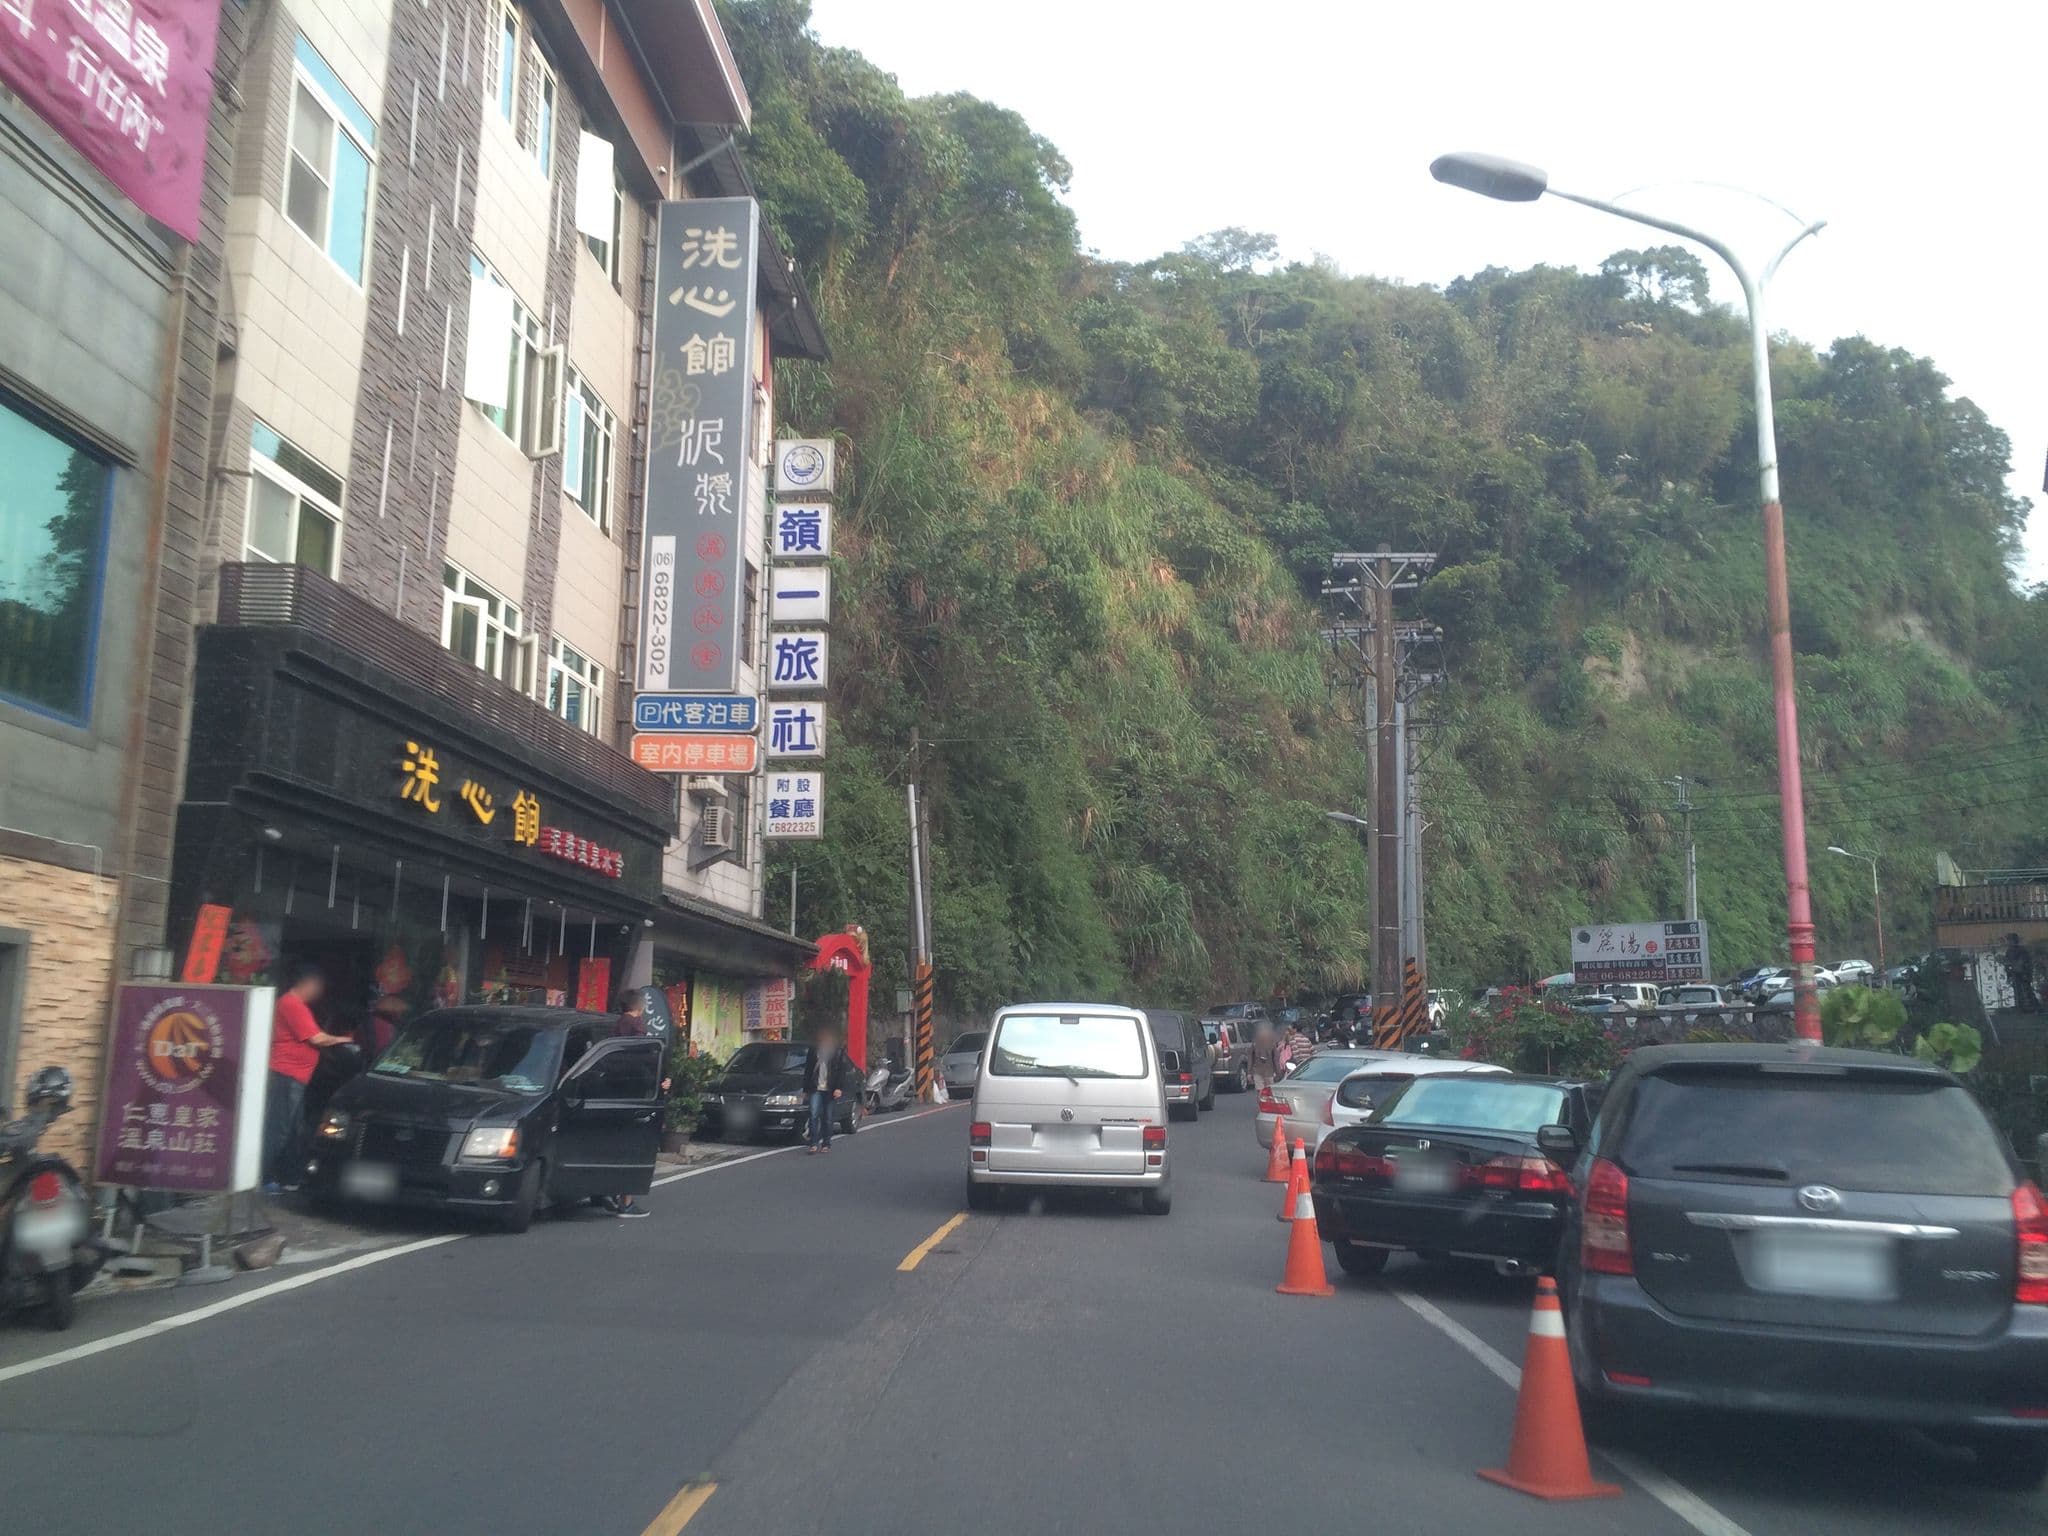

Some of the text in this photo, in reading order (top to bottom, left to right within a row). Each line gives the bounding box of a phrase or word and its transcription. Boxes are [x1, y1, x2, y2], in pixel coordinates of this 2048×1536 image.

[669, 224, 742, 377] 洗心館
[676, 417, 733, 516] 泥漿
[648, 571, 670, 676] 6822-302
[771, 509, 822, 752] 嶺一旅社
[401, 740, 542, 847] 洗心館
[640, 742, 749, 766] 室內停車場
[776, 777, 810, 793] 附設
[768, 798, 815, 820] 餐廳
[774, 821, 816, 833] 6822325
